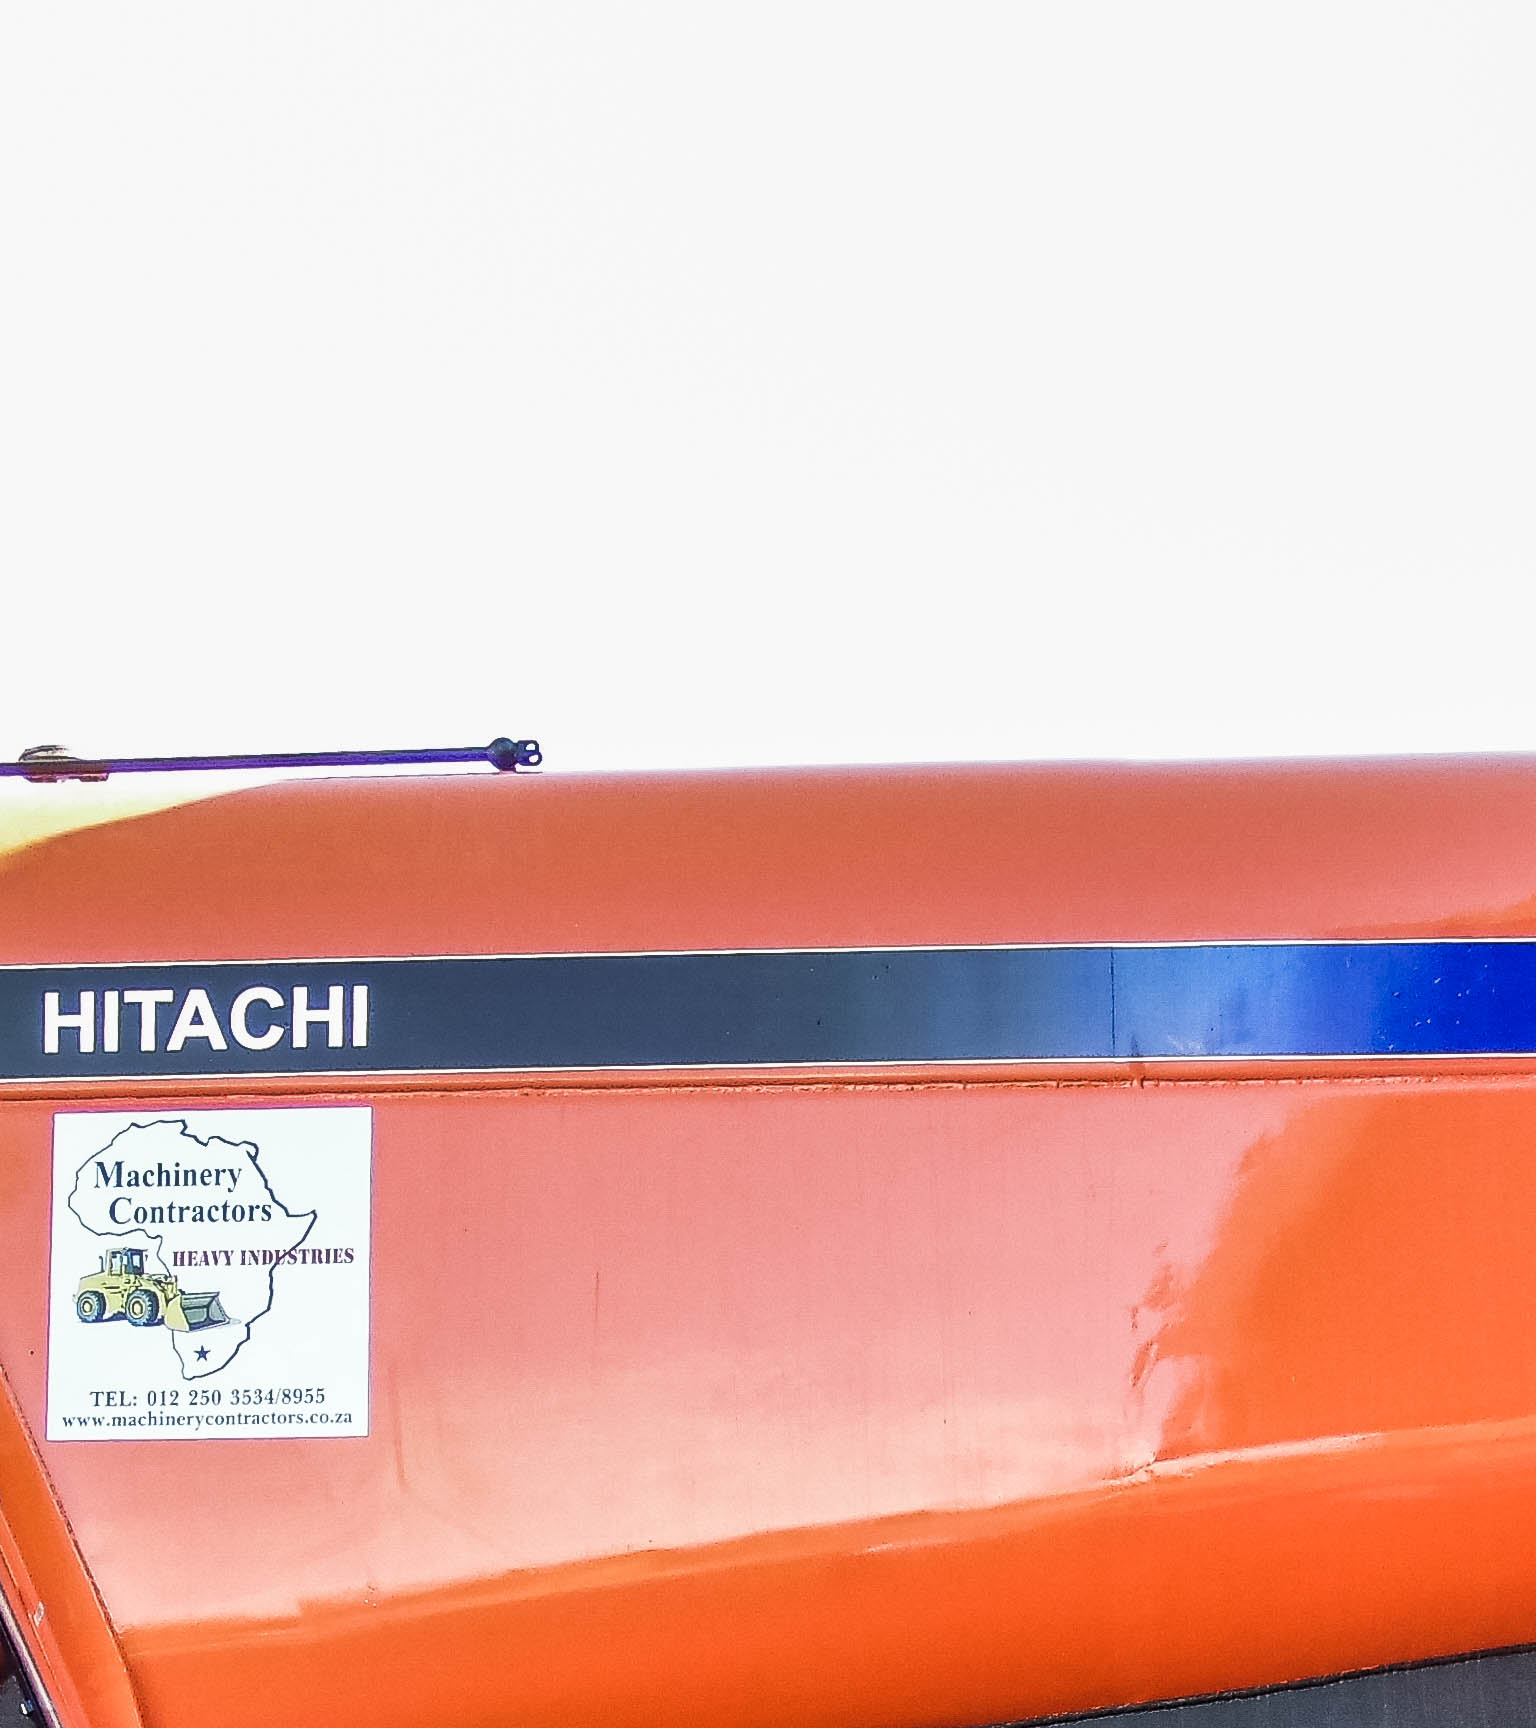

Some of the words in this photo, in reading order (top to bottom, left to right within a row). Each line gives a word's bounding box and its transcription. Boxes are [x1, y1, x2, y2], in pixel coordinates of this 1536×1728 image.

[43, 984, 369, 1054] HITACHI
[93, 1160, 242, 1192] Machinery
[108, 1196, 272, 1225] Contractors
[172, 1249, 234, 1267] HEAVY
[240, 1247, 355, 1266] INDUSTRIES
[89, 1390, 138, 1408] TEL:
[146, 1389, 180, 1407] 012
[188, 1388, 222, 1406] 250
[229, 1387, 326, 1406] 3534/8955
[62, 1409, 353, 1431] www.machinerycontractors.co.za
